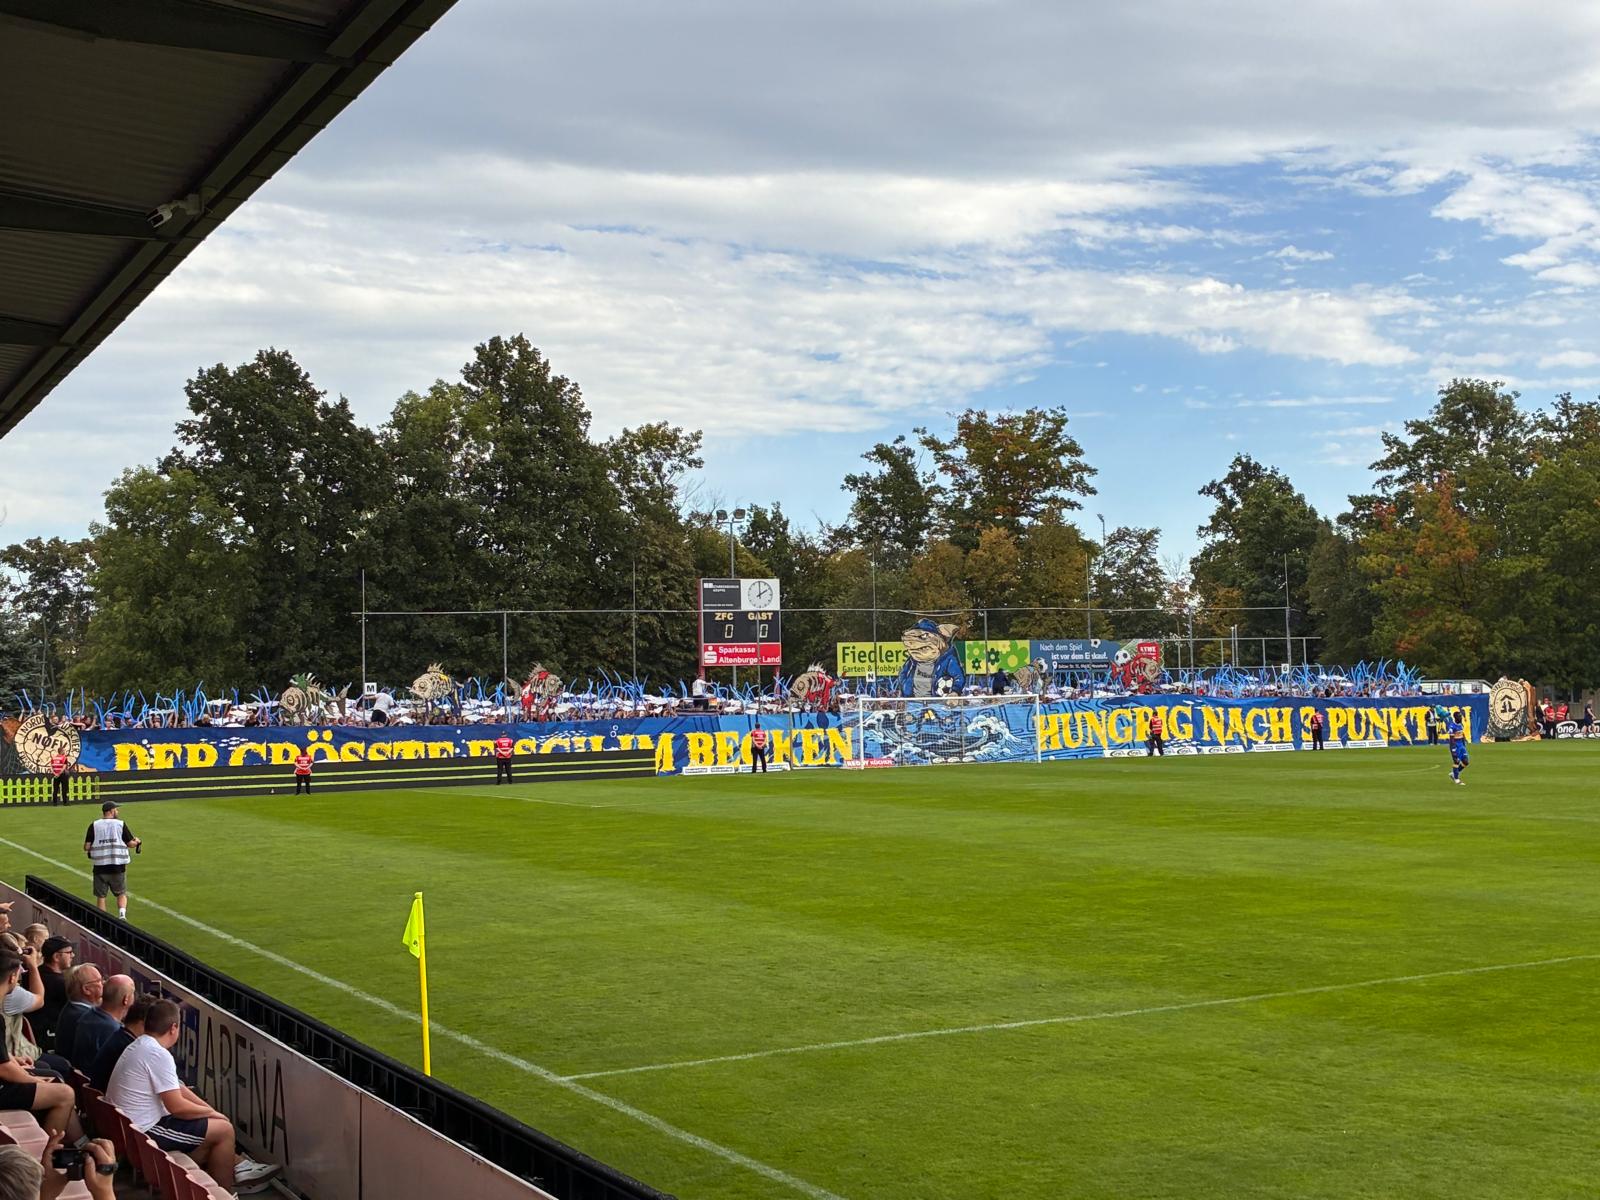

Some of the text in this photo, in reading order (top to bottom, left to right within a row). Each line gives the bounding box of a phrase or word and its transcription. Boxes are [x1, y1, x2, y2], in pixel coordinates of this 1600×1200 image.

[714, 612, 773, 621] ZFC GAST
[724, 624, 769, 638] 0 0
[718, 646, 755, 655] Sparkasse
[1039, 642, 1083, 652] Nach dem Spiel
[762, 655, 780, 663] Land
[842, 645, 908, 664] Fiedlers
[1051, 652, 1059, 660] ist
[1071, 652, 1084, 660] dem
[842, 665, 865, 673] Garten
[684, 727, 854, 768] BECKEN
[1032, 705, 1194, 751] HUNGRIG
[1200, 705, 1294, 749] NACH
[203, 1016, 289, 1166] ARENA
